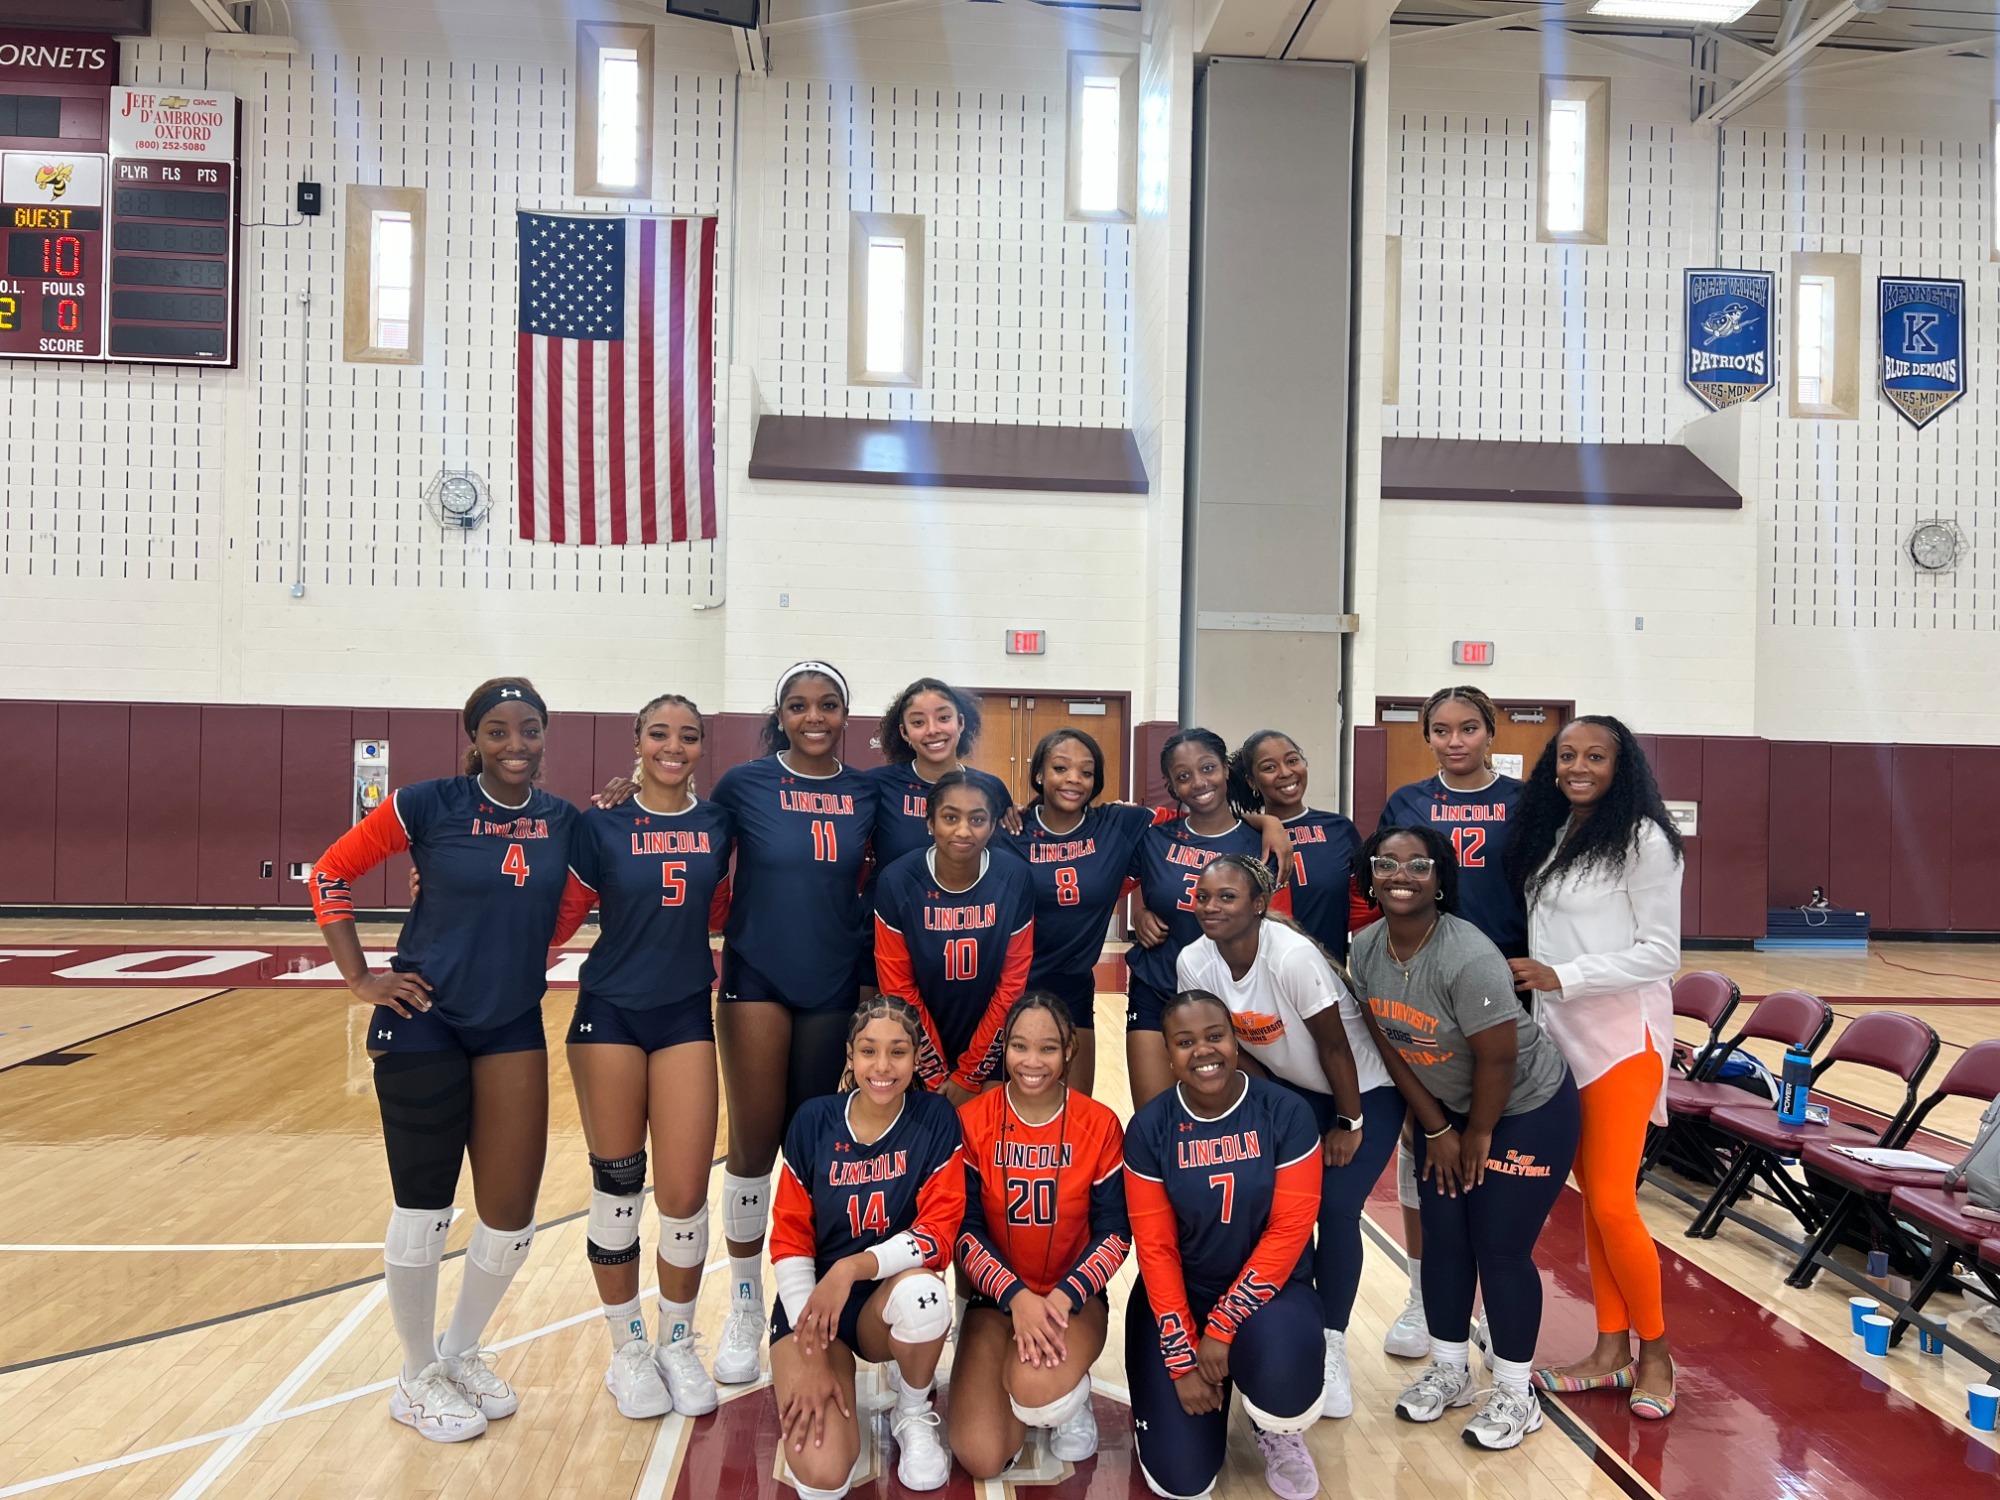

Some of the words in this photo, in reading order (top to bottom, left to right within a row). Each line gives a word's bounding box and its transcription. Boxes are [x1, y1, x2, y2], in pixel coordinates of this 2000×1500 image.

[121, 92, 156, 117] JEFF
[193, 99, 217, 107] GMC
[141, 109, 223, 127] D'AMBROSIO
[135, 141, 160, 150] (800)
[162, 141, 206, 152] 252-5080
[155, 125, 211, 141] OXFORD
[121, 165, 148, 179] PLYR
[162, 167, 181, 181] FLS
[197, 168, 218, 183] PTS
[15, 208, 72, 229] GUEST
[44, 236, 80, 277] 10
[42, 281, 85, 296] FOULS
[1692, 276, 1727, 304] GREAT
[1728, 277, 1767, 307] VALLEY
[1884, 284, 1958, 315] KENNETT
[0, 297, 16, 329] 2
[58, 299, 78, 331] 0
[40, 337, 84, 352] SCORE
[1903, 311, 1939, 355] K
[1691, 348, 1765, 376] PATRIOTS
[1885, 355, 1910, 381] BLUE
[1912, 358, 1957, 384] DEMONS
[1014, 632, 1039, 652] EXIT
[1463, 643, 1488, 662] EXIT
[780, 790, 854, 815] LINCOLN
[1431, 803, 1506, 821] LINCOLN
[632, 831, 711, 855] LINCOLN
[811, 820, 837, 862] 11
[1284, 825, 1327, 845] COLN
[1450, 827, 1486, 868] 12
[501, 843, 530, 887] 4
[1030, 838, 1096, 864] LINCOLN
[661, 861, 687, 906] 5
[1055, 867, 1080, 906] 8
[1177, 872, 1200, 912] 3
[924, 903, 996, 931] LINCOLN
[943, 937, 978, 981] 10
[1391, 1000, 1439, 1035] UNIVERSITY
[994, 1140, 1073, 1170] LINCOLN
[1178, 1131, 1261, 1169] LINCOLN
[829, 1150, 907, 1186] LINCOLN
[1484, 1158, 1551, 1177] VOLLEYBALL
[1007, 1177, 1058, 1226] 20
[1208, 1172, 1234, 1224] 7
[847, 1191, 890, 1239] 14
